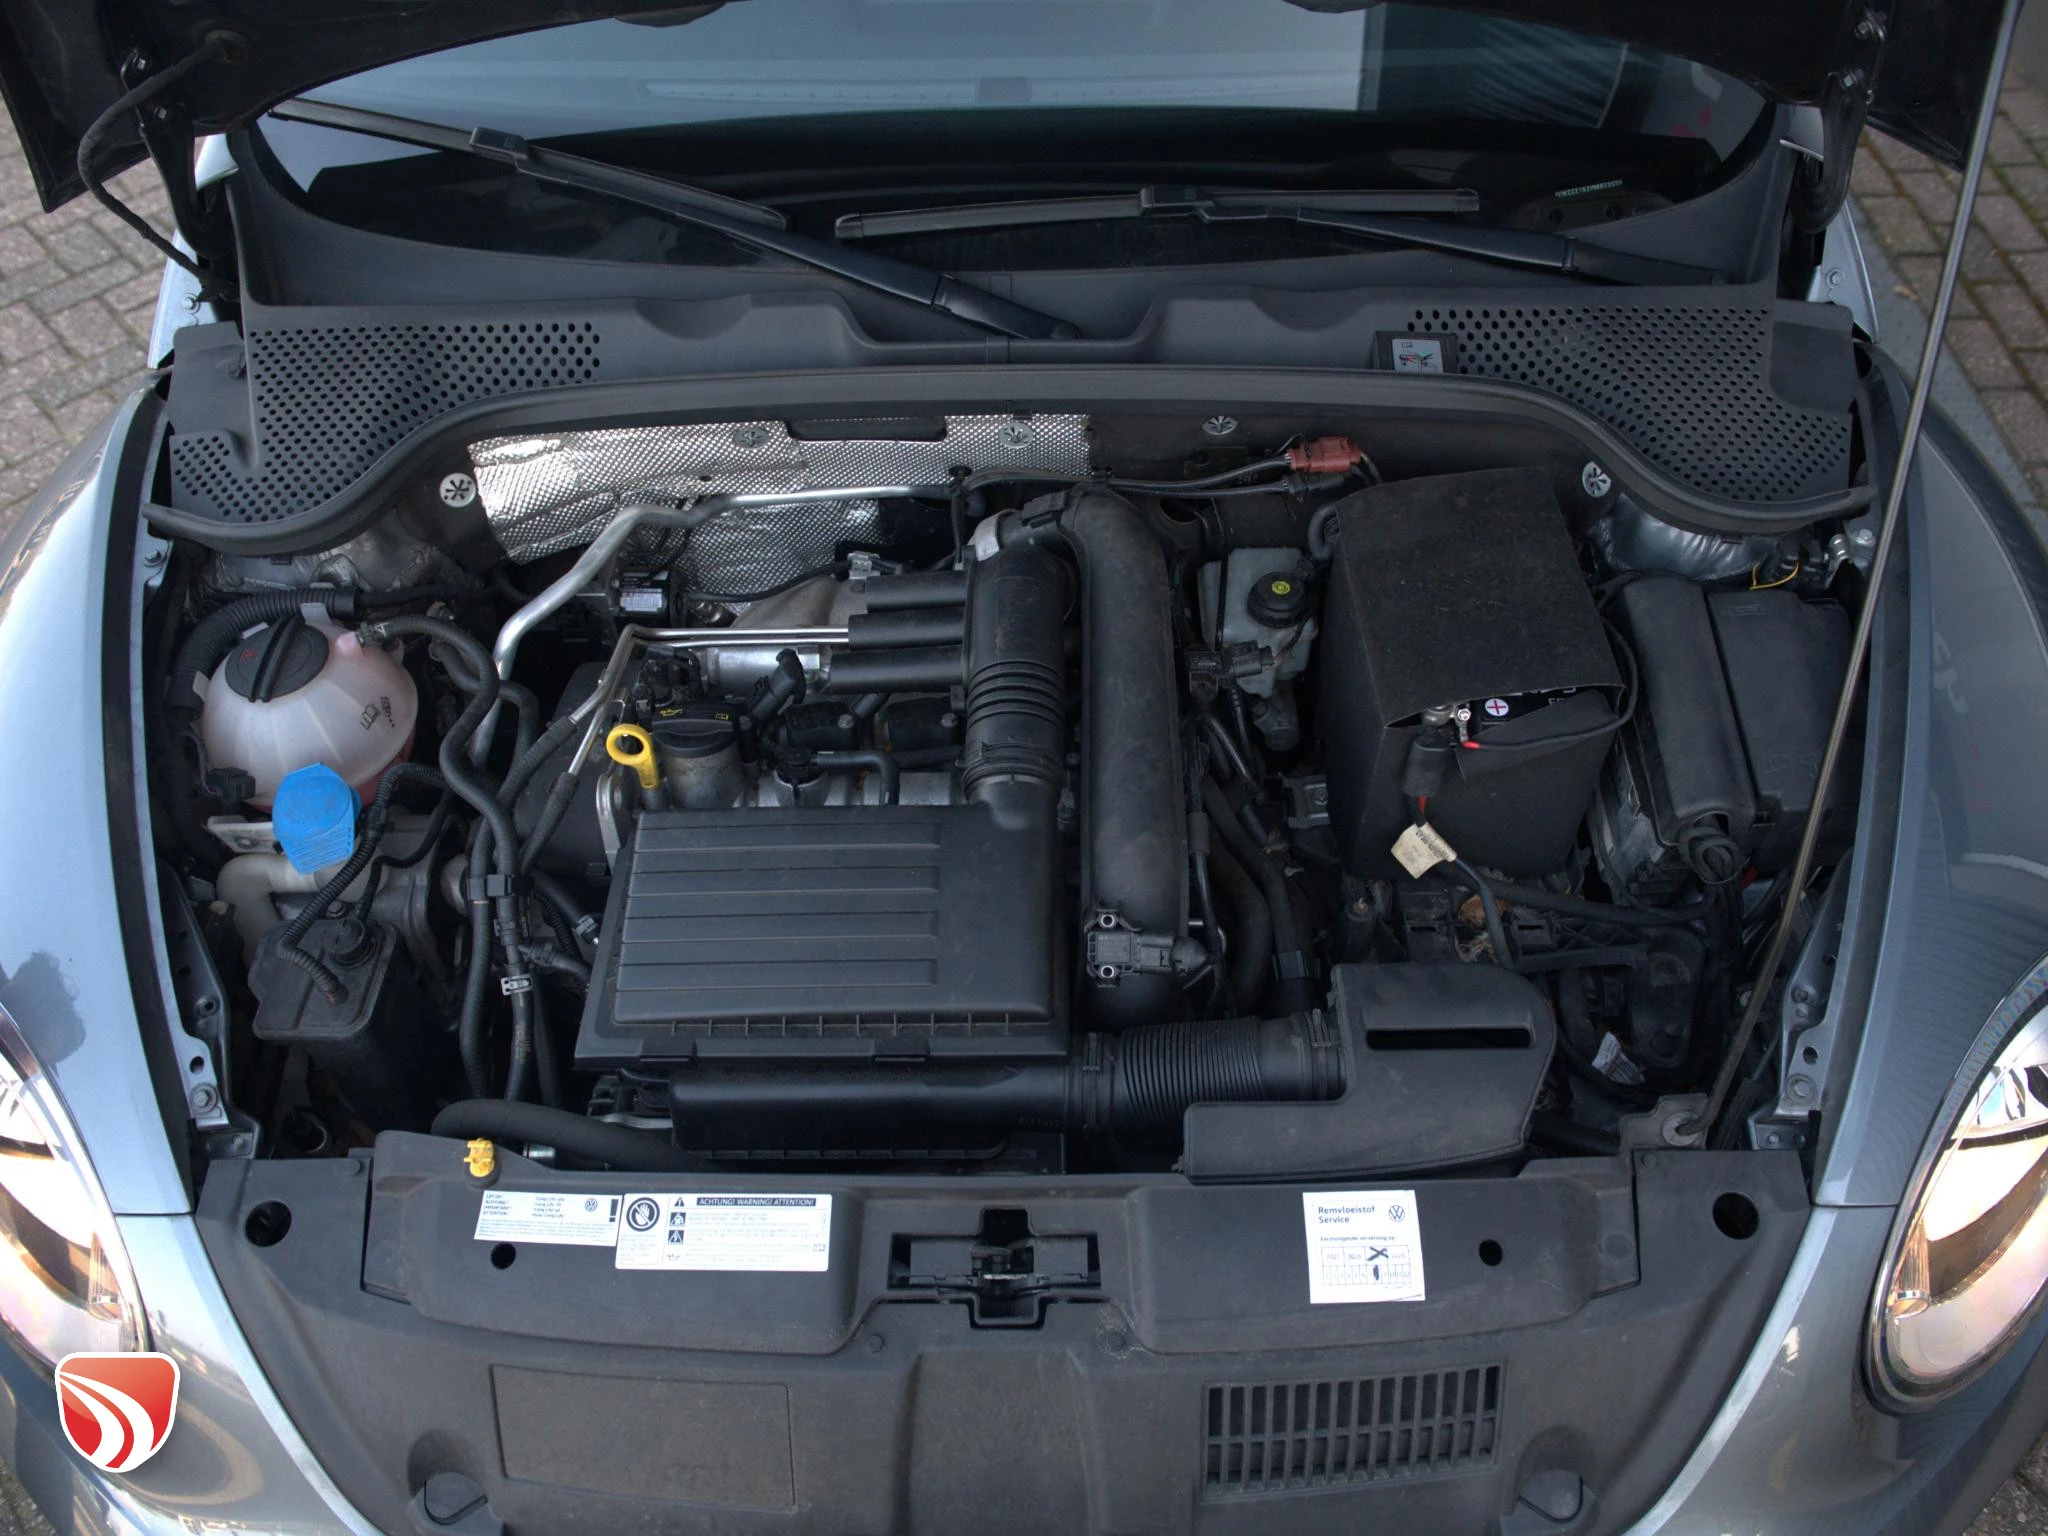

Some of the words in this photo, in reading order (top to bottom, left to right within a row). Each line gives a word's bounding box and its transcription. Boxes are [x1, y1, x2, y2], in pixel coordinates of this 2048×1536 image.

[699, 1198, 735, 1206] ACHTUNG!
[736, 1198, 773, 1206] WARNING!
[774, 1198, 814, 1206] ATTENTION!
[1318, 1205, 1375, 1215] Remvloeistof
[1319, 1215, 1350, 1224] Service
